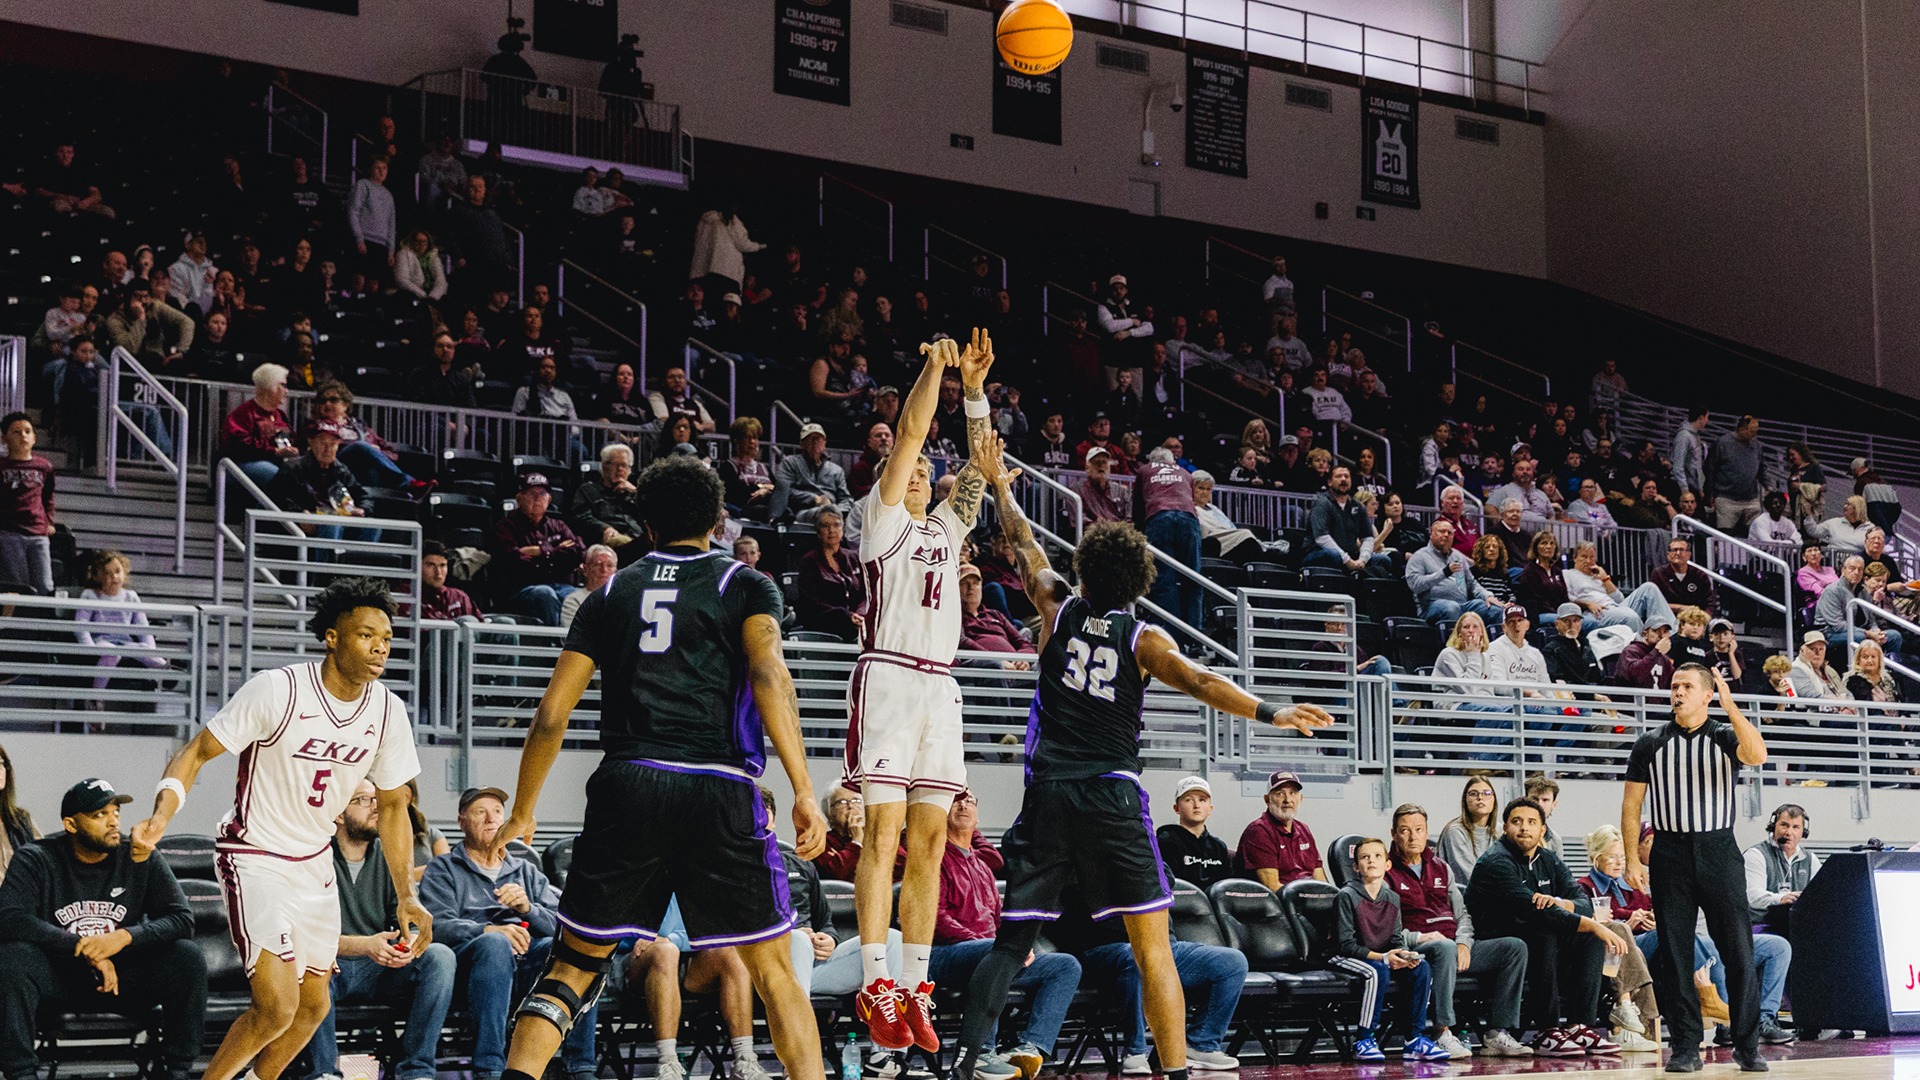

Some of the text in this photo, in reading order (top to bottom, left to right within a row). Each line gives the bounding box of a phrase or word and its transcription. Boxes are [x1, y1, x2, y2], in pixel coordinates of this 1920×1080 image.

[785, 7, 842, 28] CHAMPIONS
[789, 31, 838, 53] 1996-97
[798, 56, 828, 73] NCAA
[787, 67, 841, 87] TOURNAMENT
[1005, 75, 1052, 95] 1994-95
[1382, 152, 1402, 175] 20
[653, 565, 680, 582] LEE
[921, 571, 943, 611] 14
[639, 589, 680, 658] 5
[1081, 616, 1112, 639] MOORE
[1061, 637, 1118, 703] 32
[298, 738, 369, 763] EKU
[874, 758, 890, 769] E
[307, 769, 332, 808] 5
[55, 900, 127, 926] COLONELS
[281, 932, 288, 945] E
